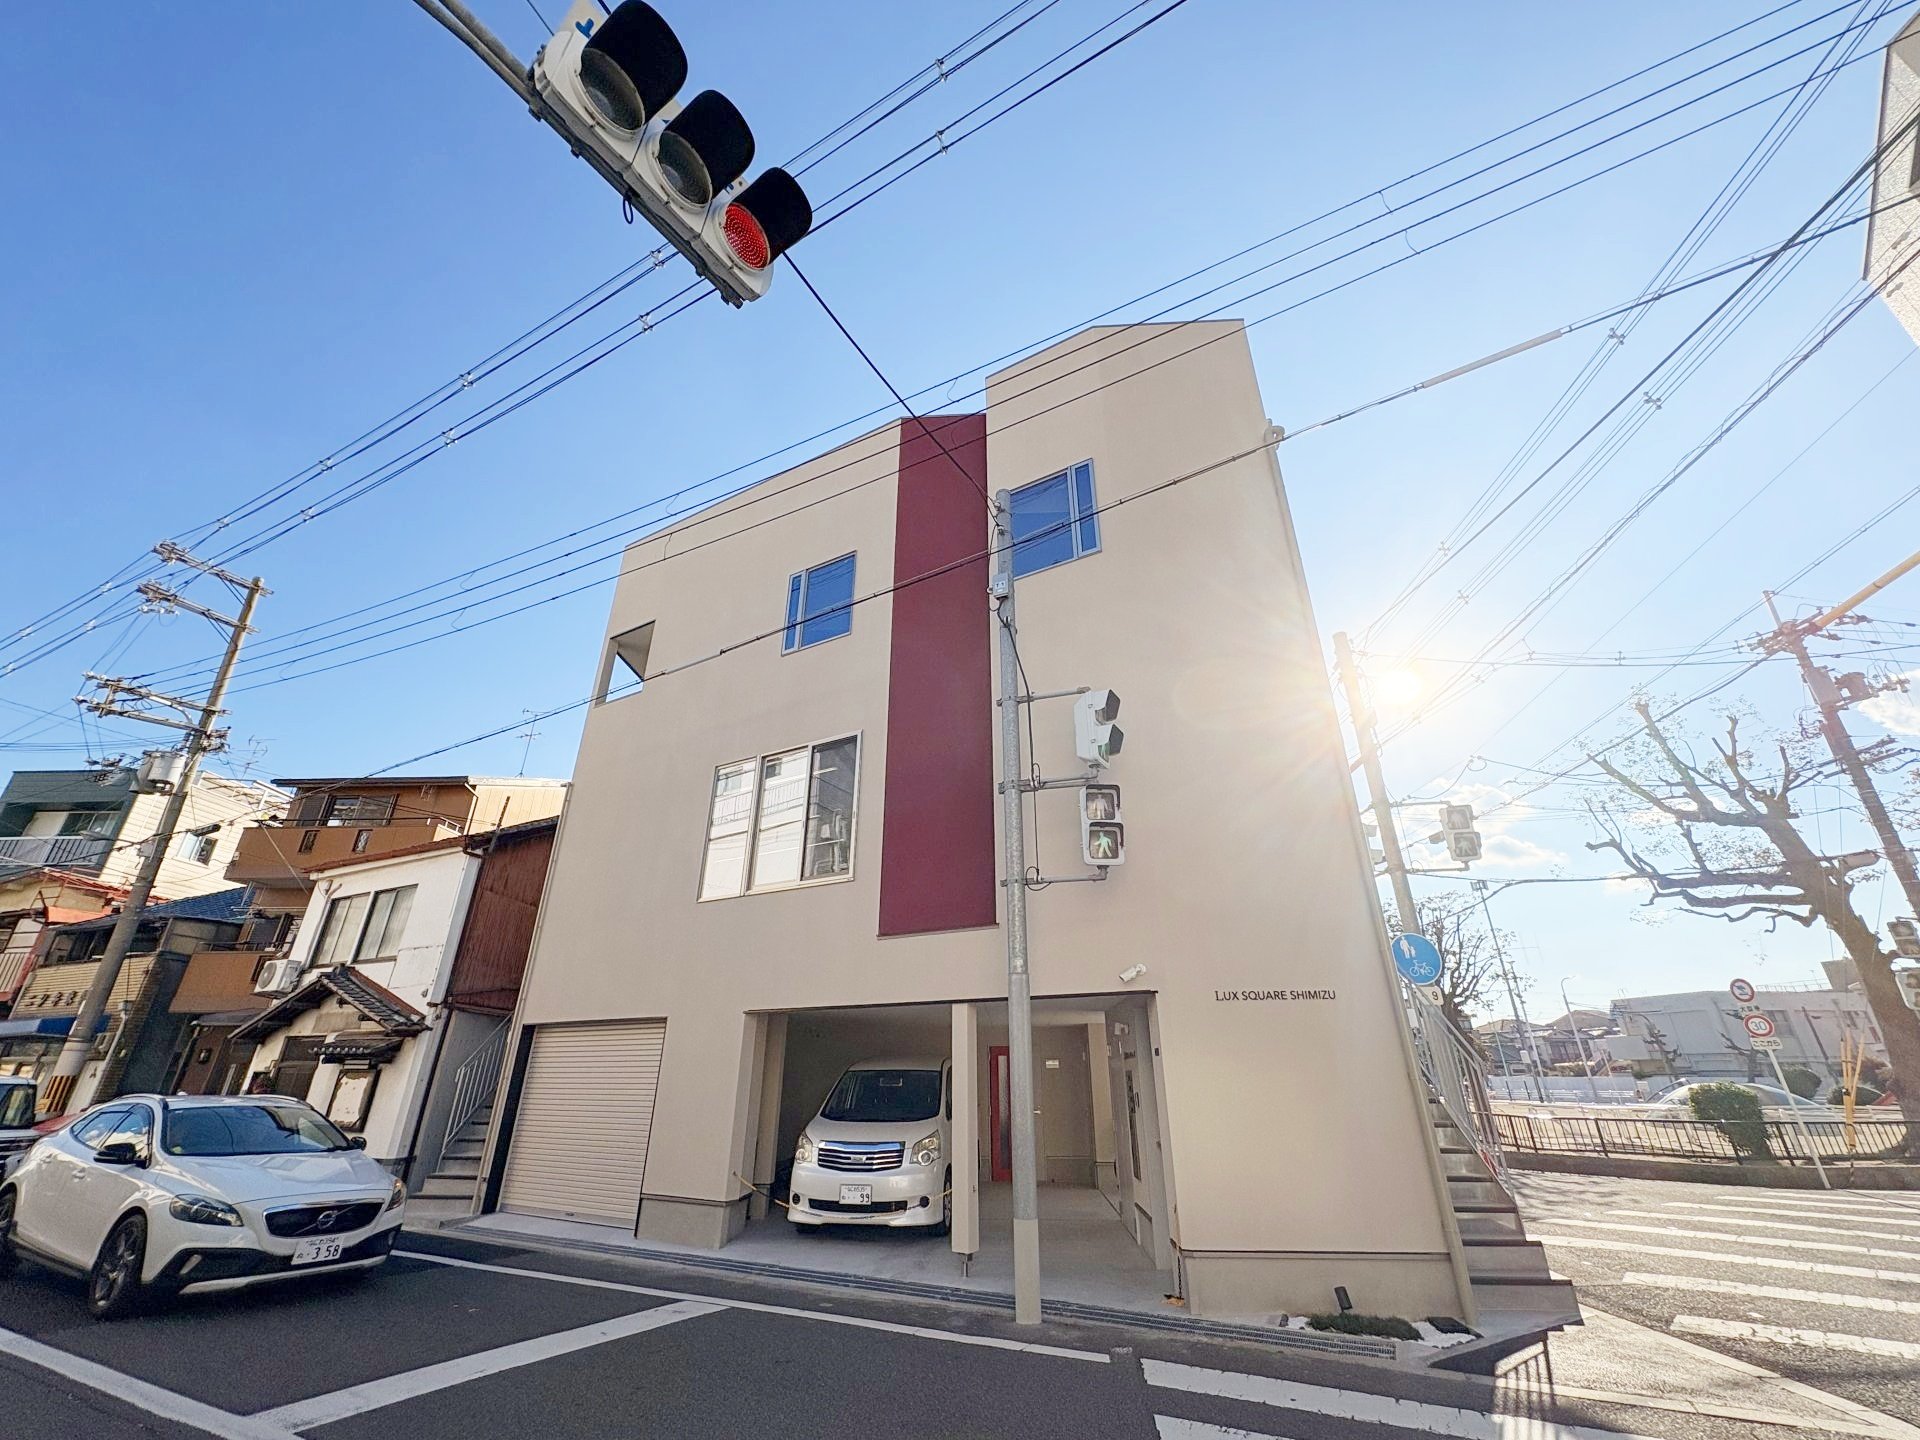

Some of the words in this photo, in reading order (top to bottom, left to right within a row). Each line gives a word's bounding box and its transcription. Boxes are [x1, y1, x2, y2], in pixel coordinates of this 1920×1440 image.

[1214, 990, 1240, 1001] LUX
[1241, 990, 1288, 1001] SQUARE
[1289, 990, 1336, 1001] SHIMIZU
[1750, 1020, 1768, 1032] 30
[1752, 1039, 1781, 1048] ここから
